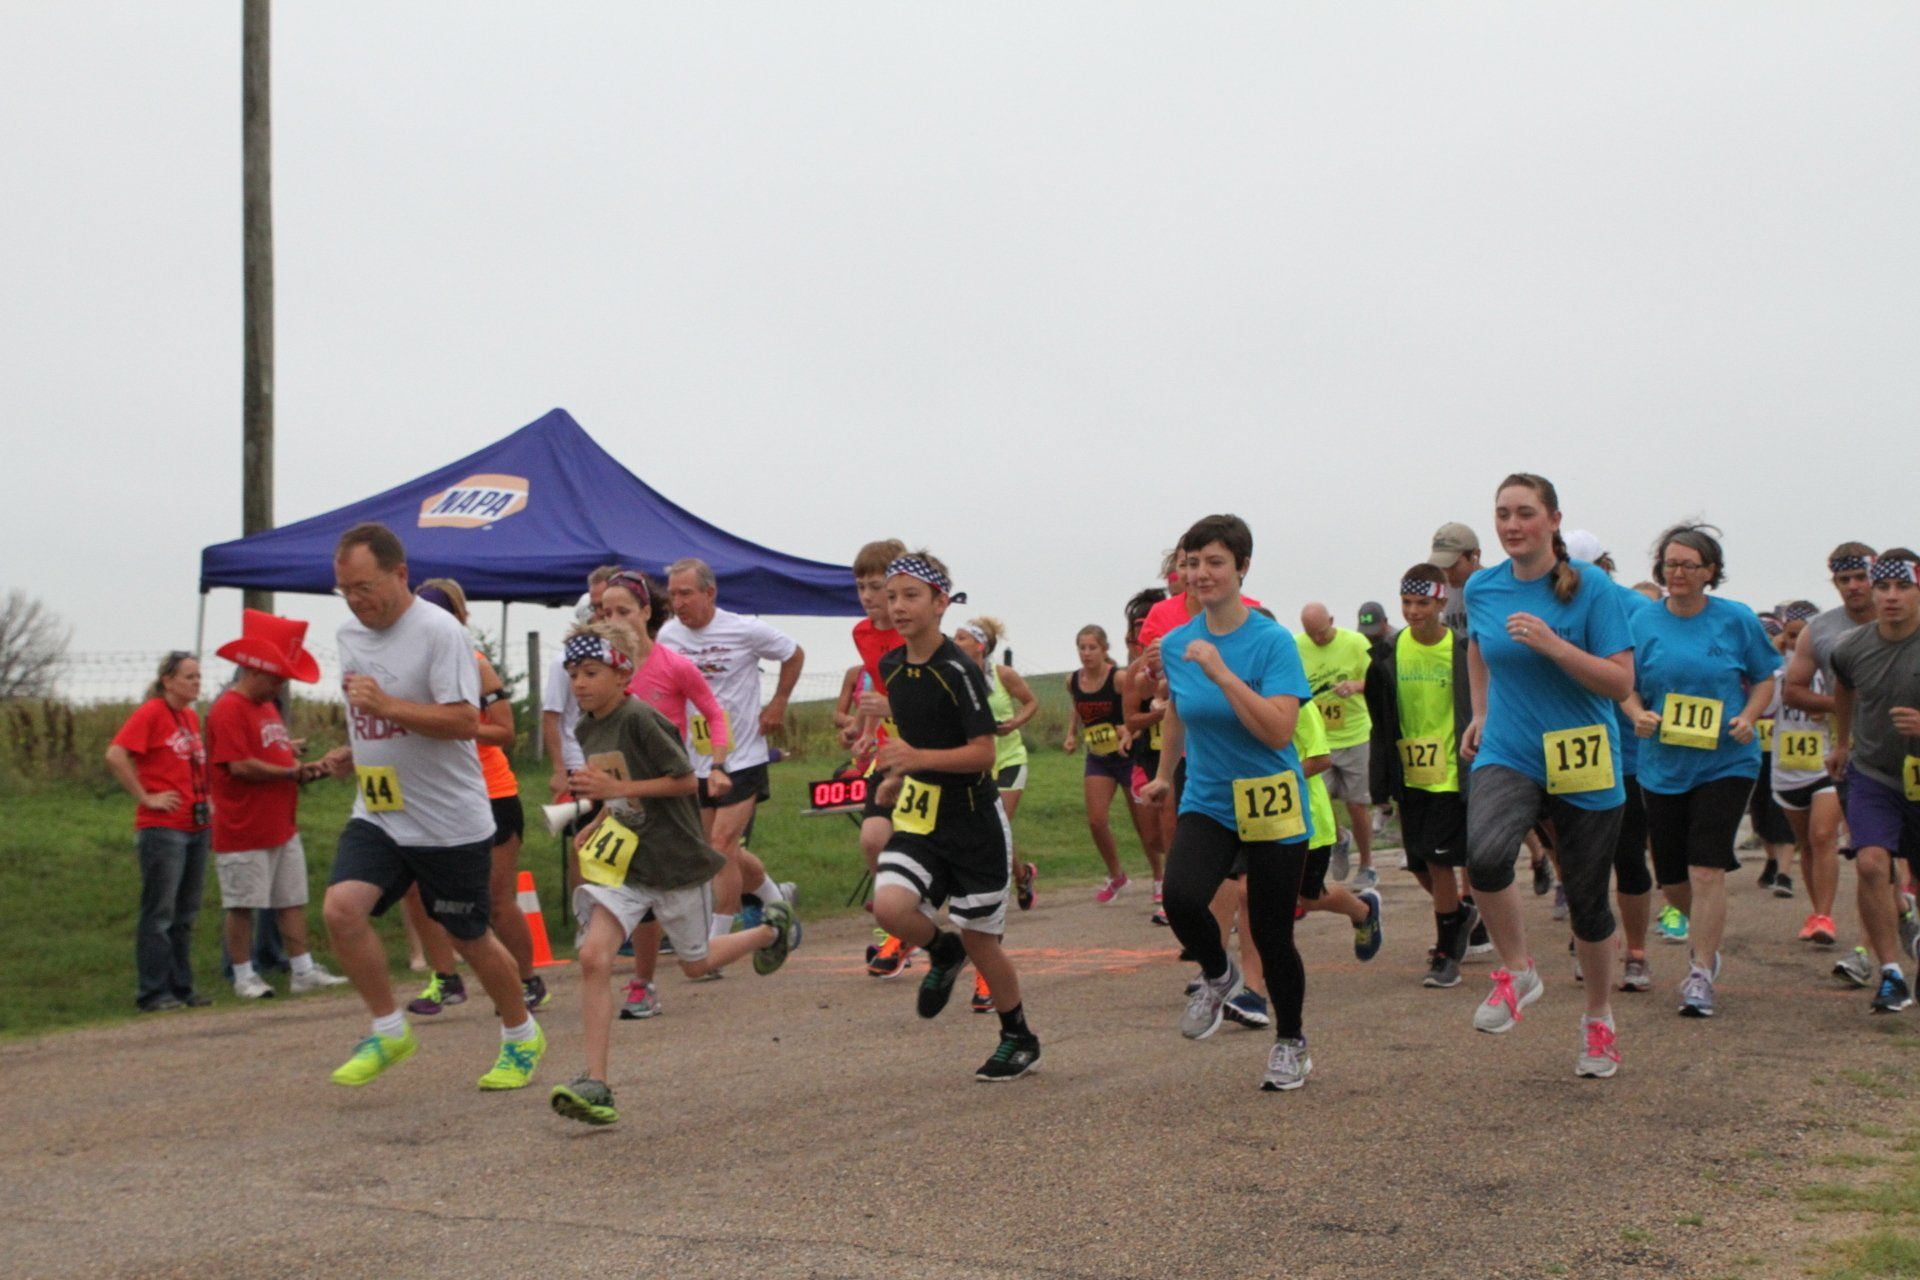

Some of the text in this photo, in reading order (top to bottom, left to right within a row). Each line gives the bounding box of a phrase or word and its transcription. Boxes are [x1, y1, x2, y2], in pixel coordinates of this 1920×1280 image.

[431, 490, 515, 517] NAPA
[1672, 702, 1713, 730] 110
[1406, 743, 1438, 767] 127
[1556, 734, 1602, 771] 137
[1786, 736, 1818, 756] 143
[900, 783, 930, 820] 34
[1245, 782, 1293, 818] 123
